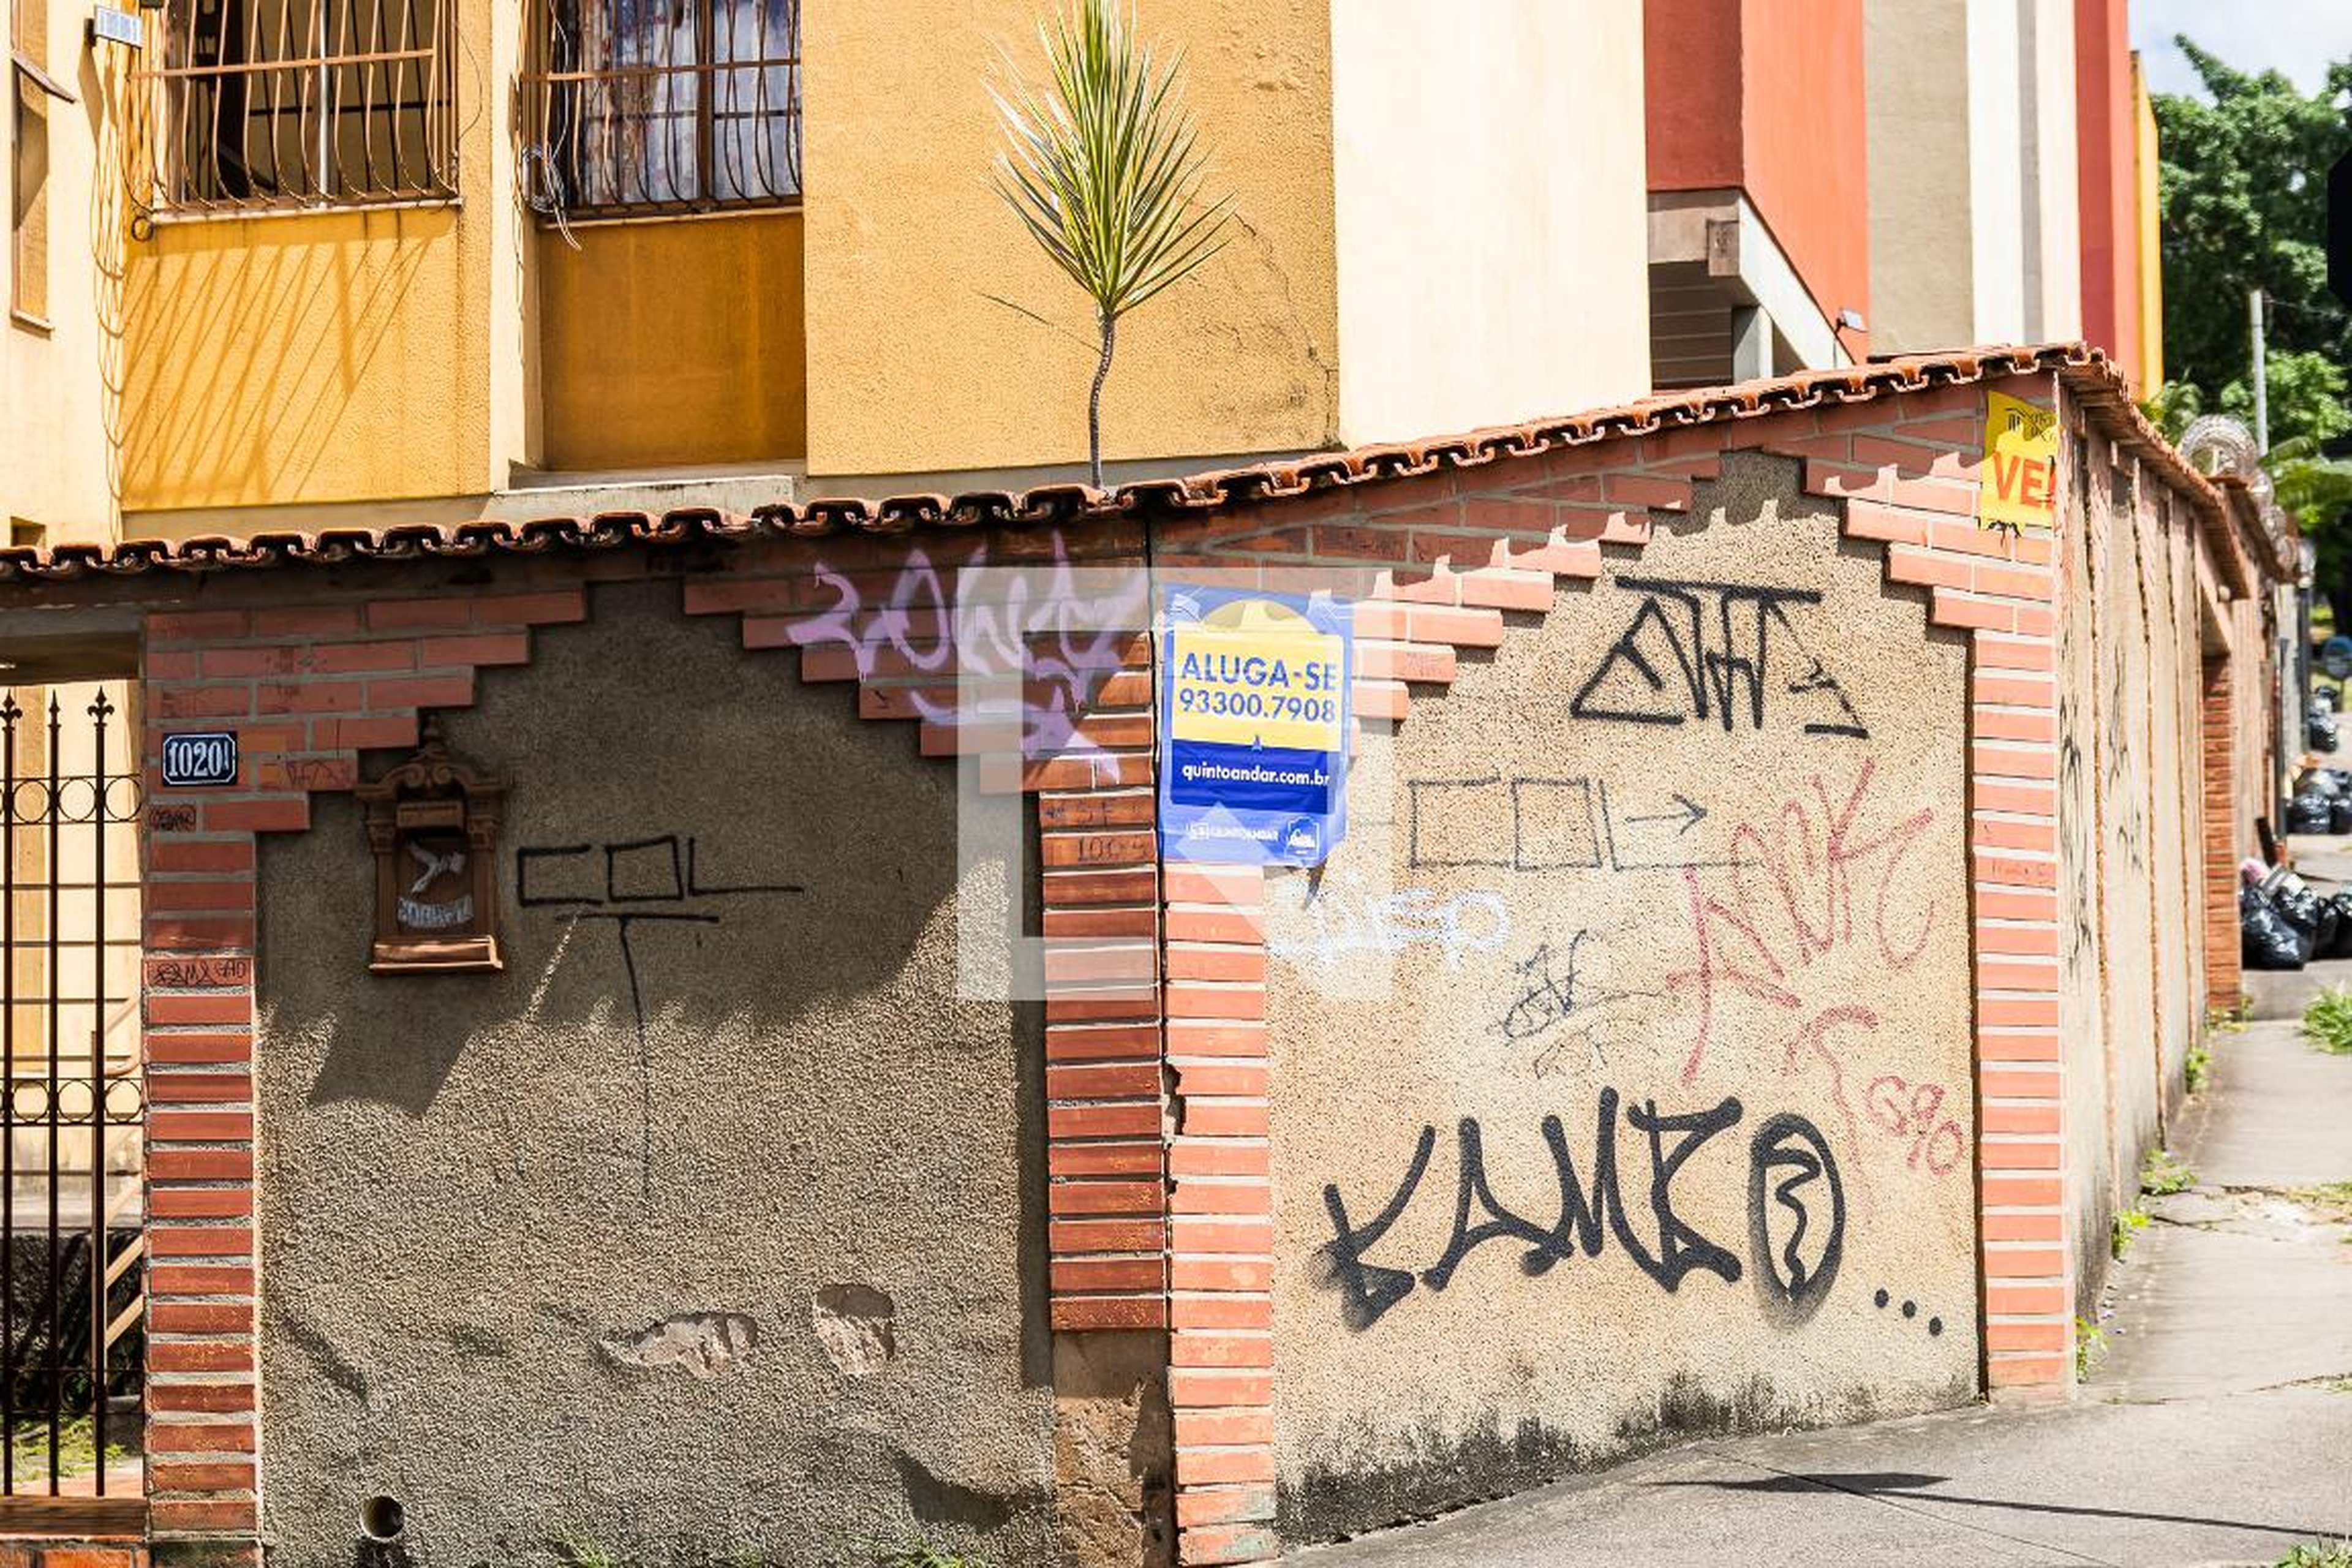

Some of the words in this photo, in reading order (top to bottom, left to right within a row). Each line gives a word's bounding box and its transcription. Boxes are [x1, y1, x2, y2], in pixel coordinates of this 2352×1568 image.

[1180, 652, 1336, 691] ALUGA-SE
[1179, 688, 1335, 722] 93300.7908
[1182, 761, 1330, 786] quintoandar.com.br
